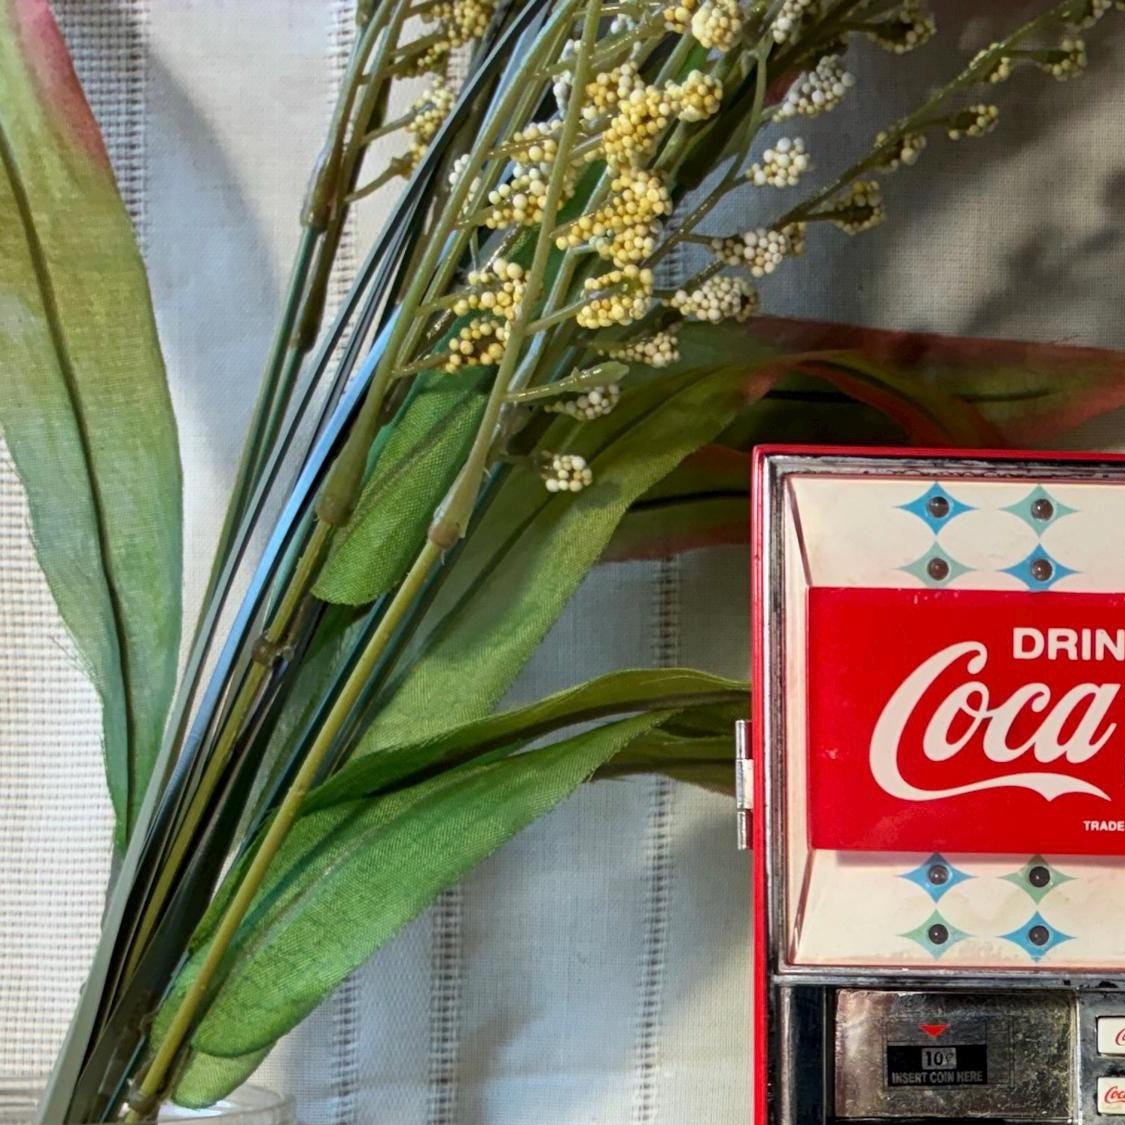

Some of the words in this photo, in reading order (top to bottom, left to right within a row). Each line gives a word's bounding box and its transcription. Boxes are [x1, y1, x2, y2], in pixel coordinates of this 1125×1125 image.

[892, 1071, 928, 1084] INSERT
[929, 1070, 955, 1083] COIN
[956, 1070, 984, 1083] HERE
